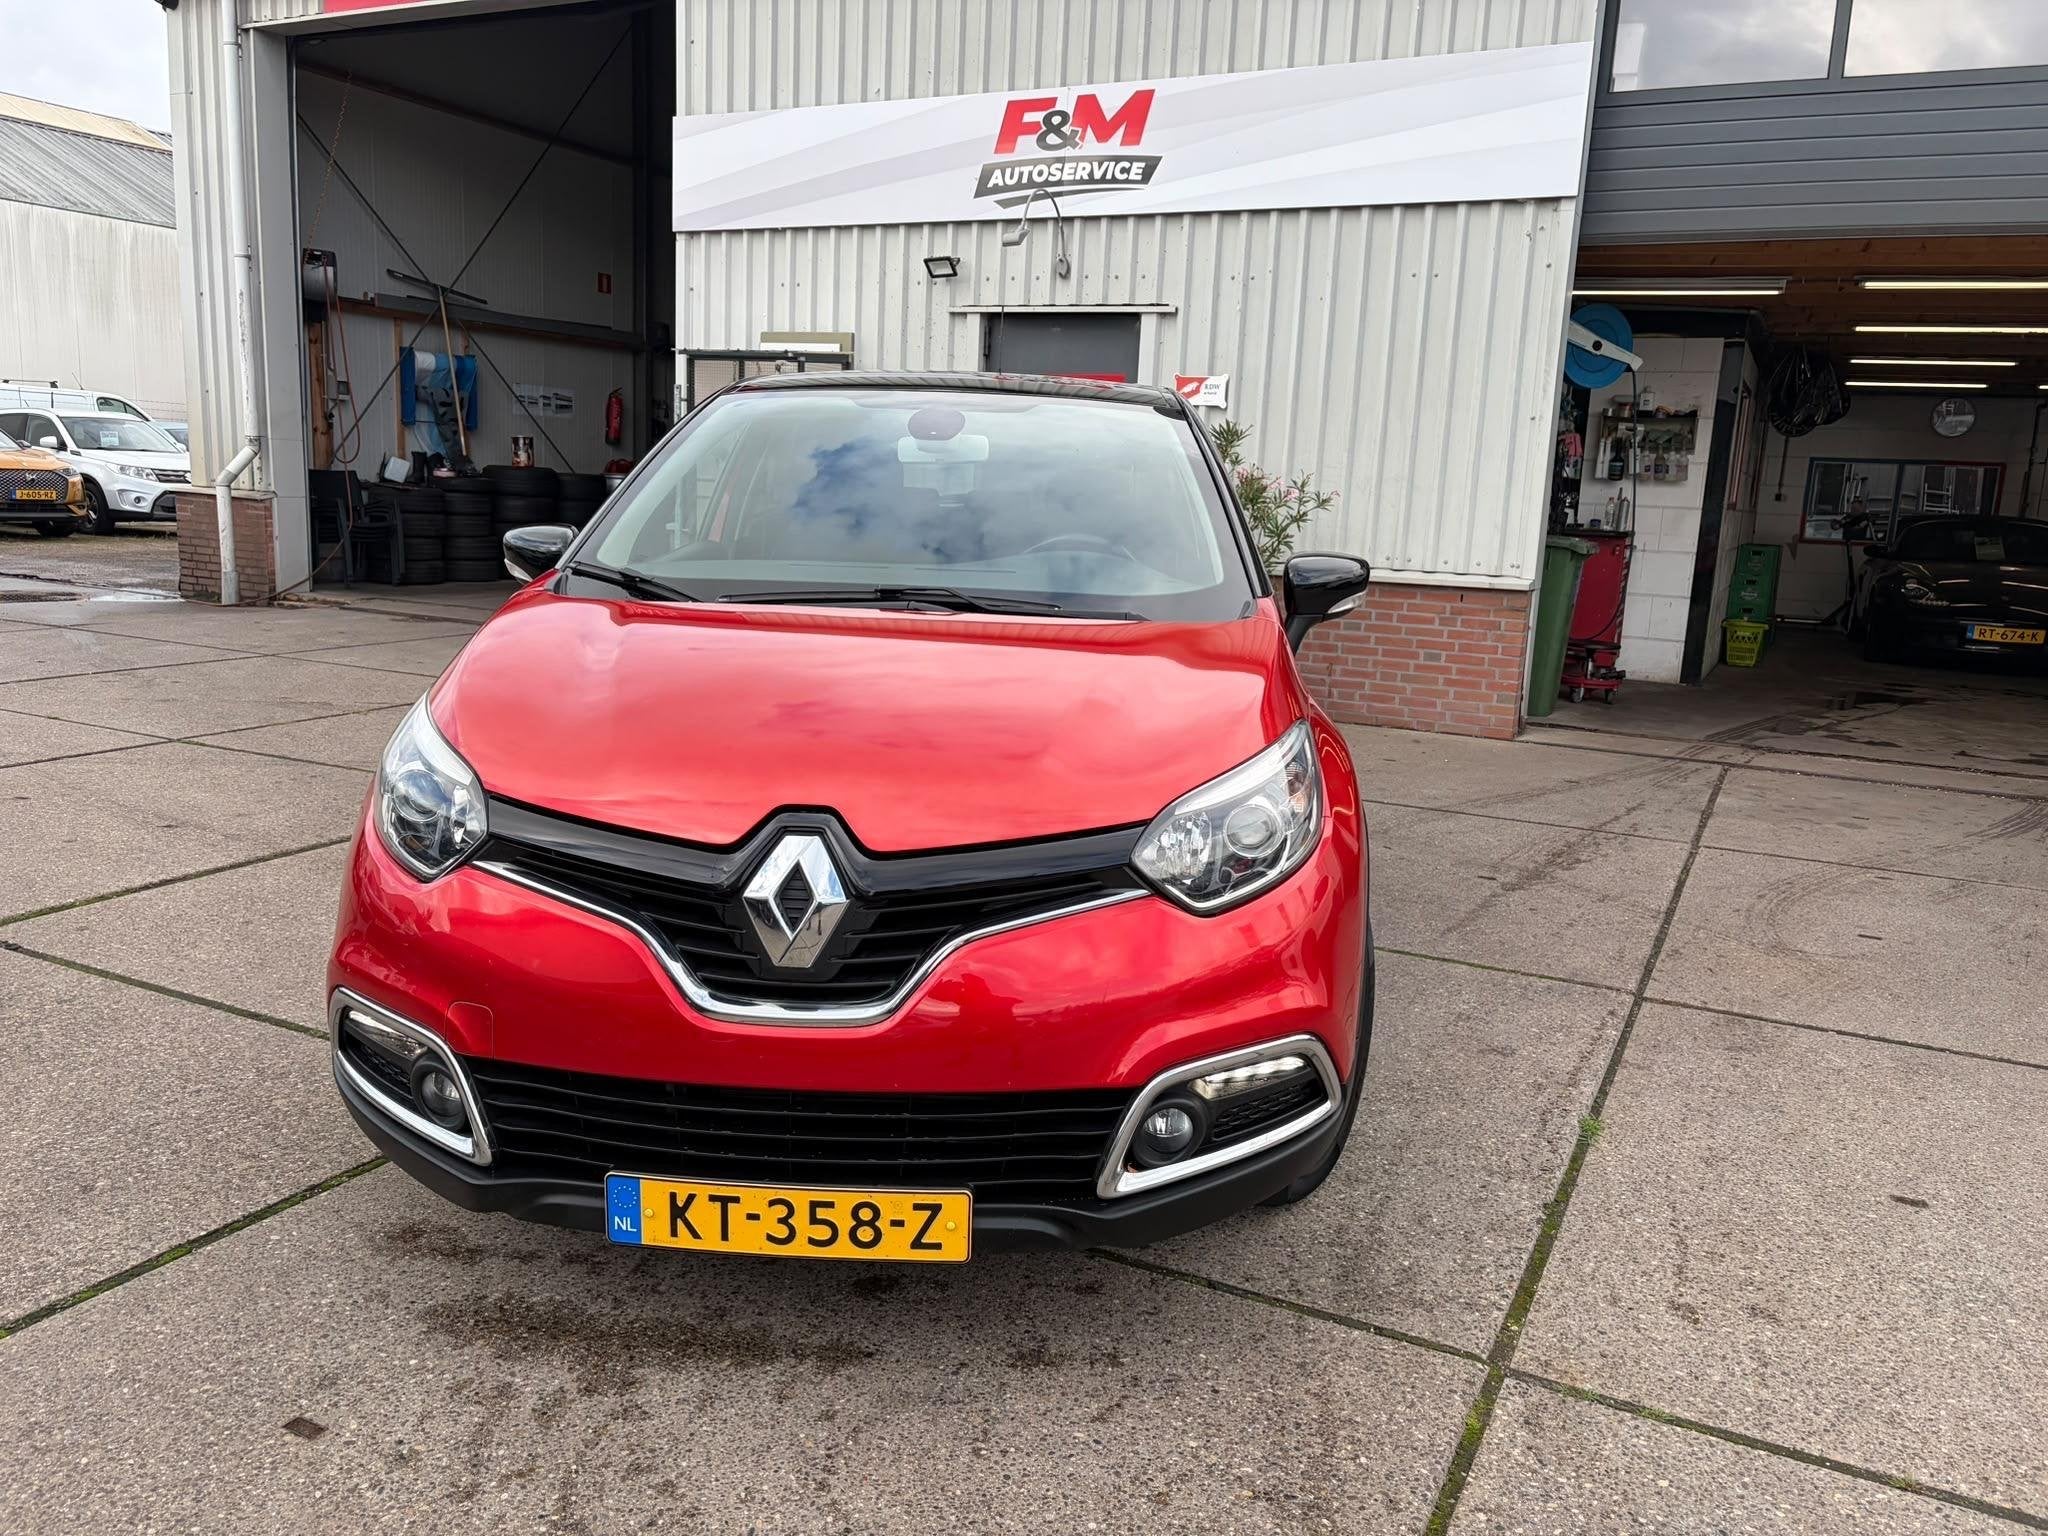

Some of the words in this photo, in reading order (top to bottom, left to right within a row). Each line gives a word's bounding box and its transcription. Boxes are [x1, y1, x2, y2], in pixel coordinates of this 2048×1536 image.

[993, 88, 1156, 154] F&M
[986, 160, 1146, 189] AUTOSERVICE
[19, 491, 54, 499] J-605-RZ
[1978, 627, 2040, 642] RT-674-K
[614, 1215, 638, 1233] NL
[668, 1190, 944, 1251] KT-358-Z
